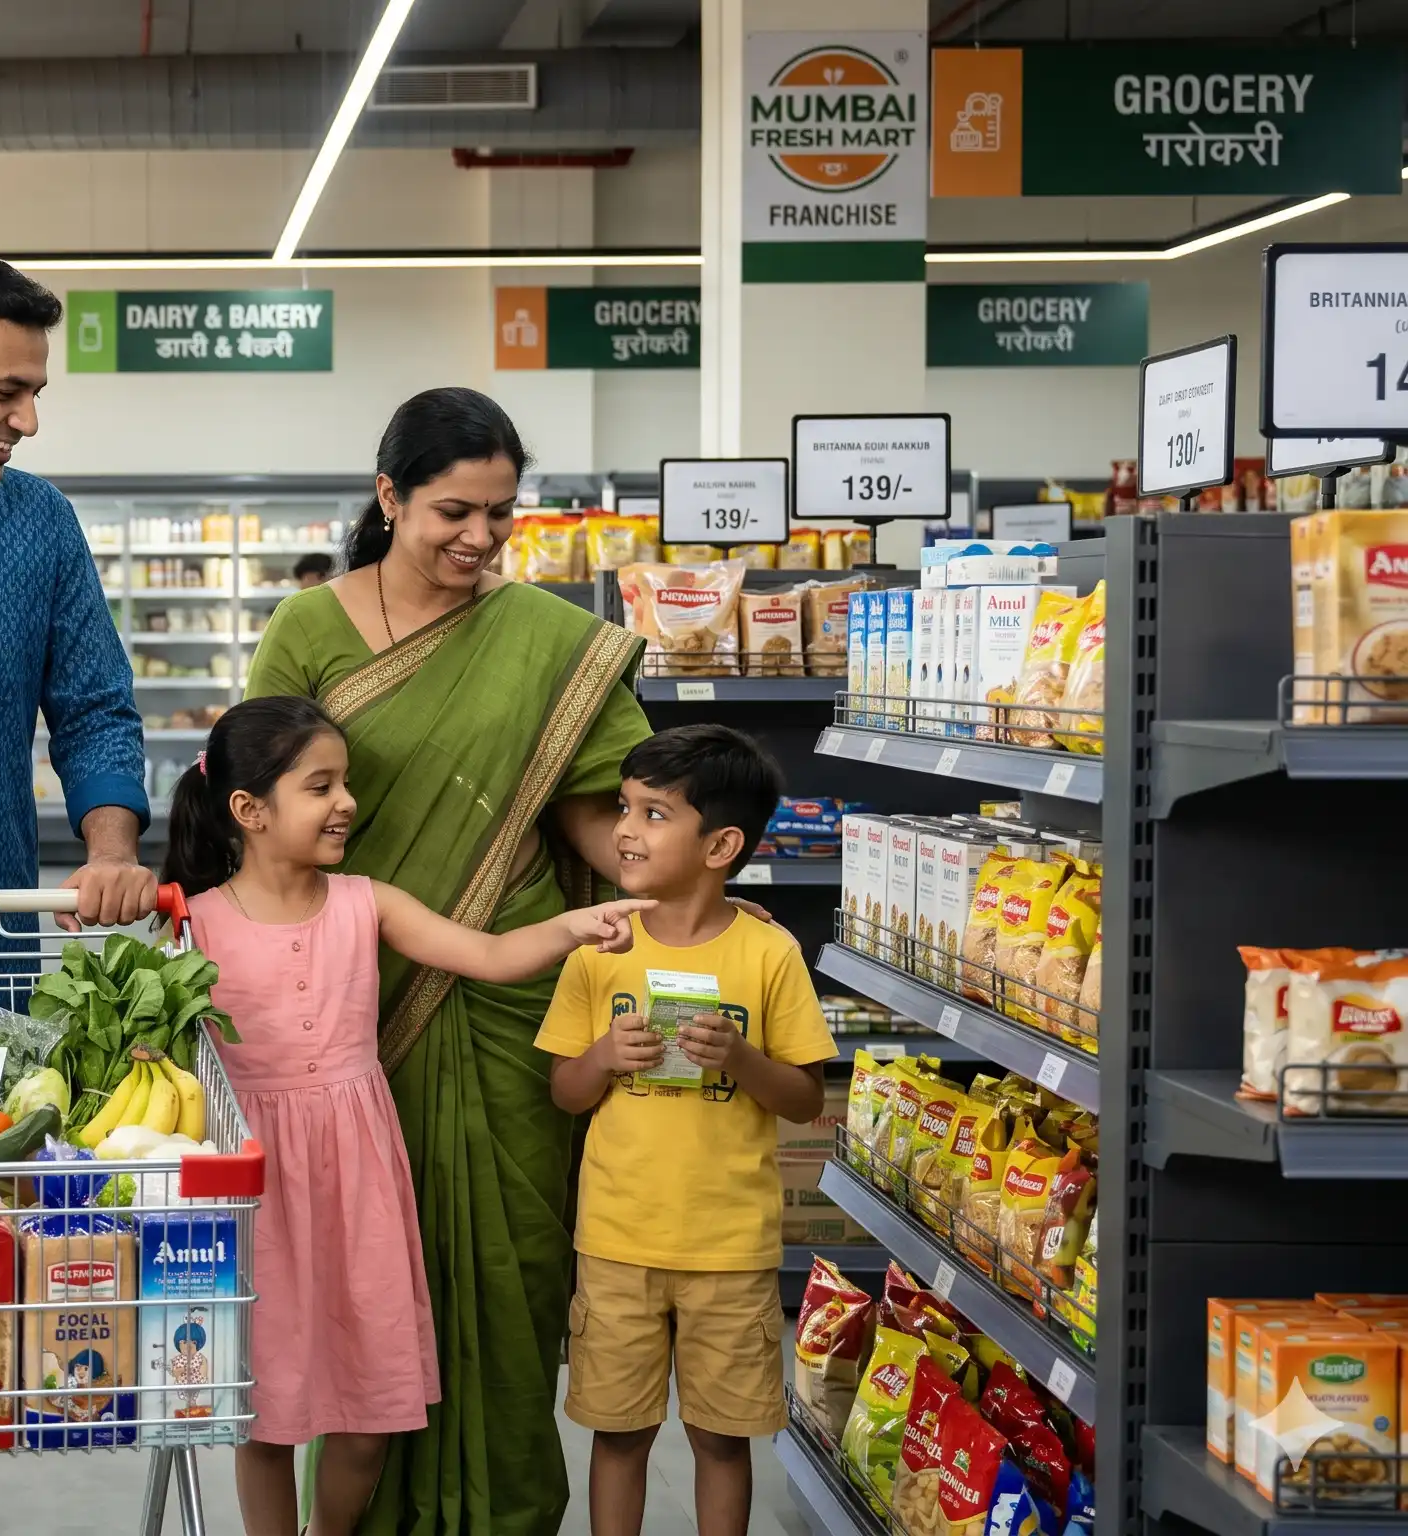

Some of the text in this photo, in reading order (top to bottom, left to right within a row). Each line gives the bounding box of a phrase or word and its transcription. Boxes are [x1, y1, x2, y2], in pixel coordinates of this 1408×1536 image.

[1114, 73, 1314, 115] GROCERY
[750, 93, 916, 123] MUMBAI
[750, 128, 916, 148] FRESH MART
[1142, 120, 1283, 167] गरोकरी
[769, 204, 897, 227] FRANCHISE
[978, 297, 1091, 323] GROCERY
[1309, 292, 1408, 308] BRITANNIA
[126, 304, 323, 329] DAIRY & BAKERY
[594, 300, 701, 326] GROCERY
[214, 336, 233, 358] &
[1167, 428, 1205, 469] 130/-
[842, 474, 913, 501] 139/-
[702, 507, 759, 531] 139/-
[986, 595, 1026, 611] Amul
[989, 616, 1021, 627] MILK
[153, 1240, 226, 1266] Amul
[58, 1313, 109, 1327] FOCAL
[55, 1327, 110, 1342] DREAD
